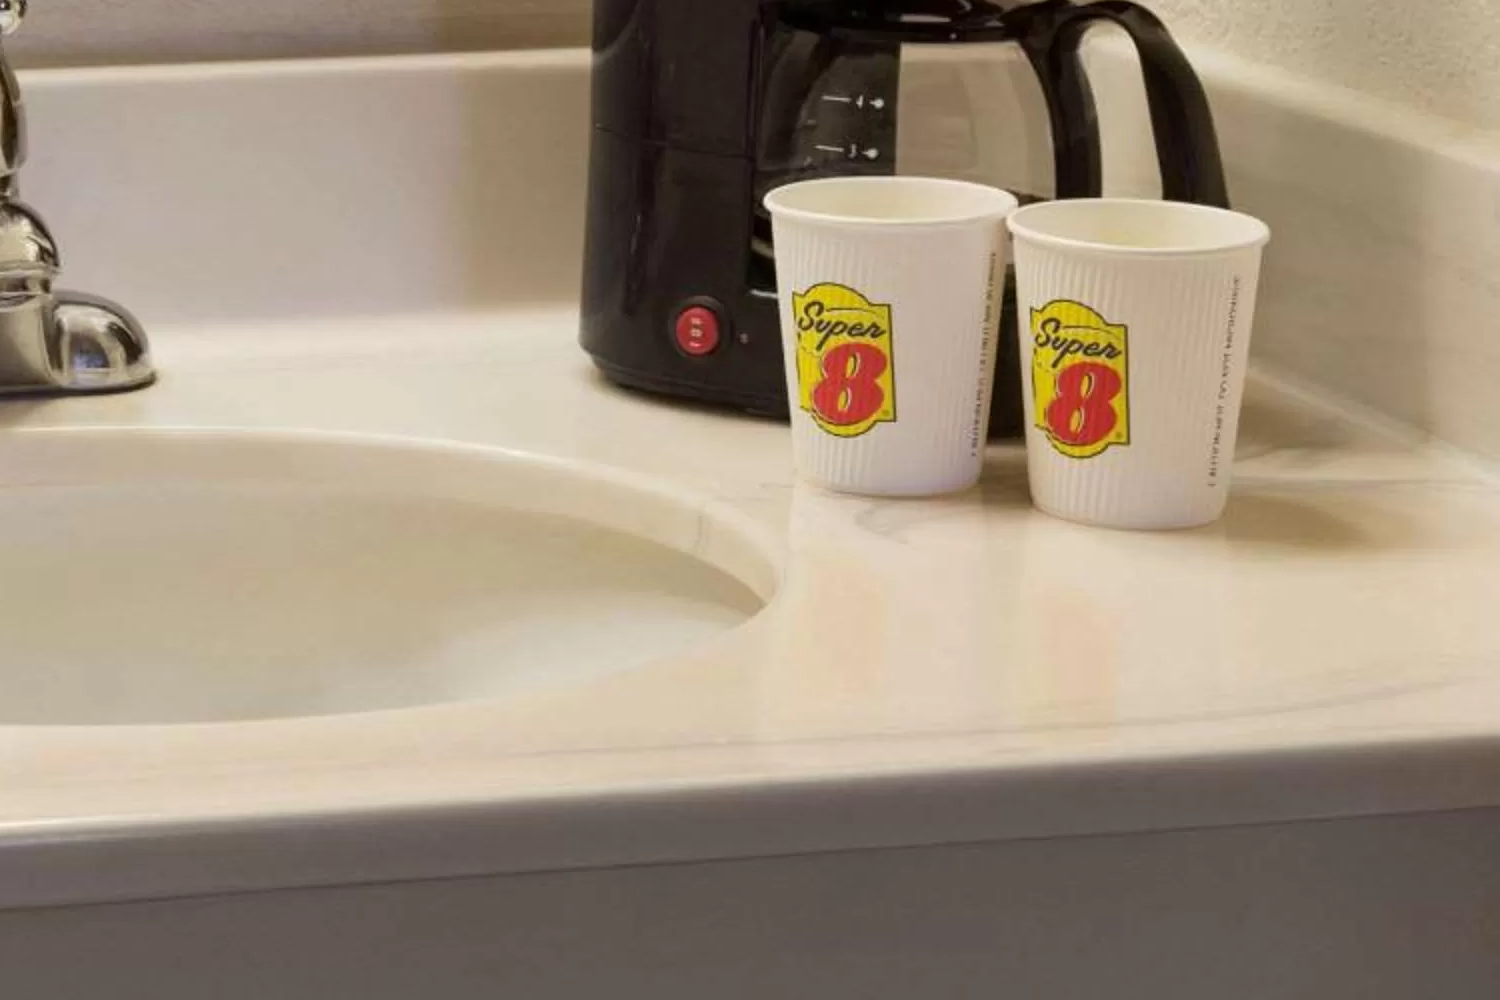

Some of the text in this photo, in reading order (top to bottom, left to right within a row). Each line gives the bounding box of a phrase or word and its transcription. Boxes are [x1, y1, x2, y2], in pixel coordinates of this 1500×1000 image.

[798, 301, 886, 351] Super
[1035, 317, 1122, 369] Super
[812, 342, 887, 425] 8
[1045, 361, 1122, 446] 8
